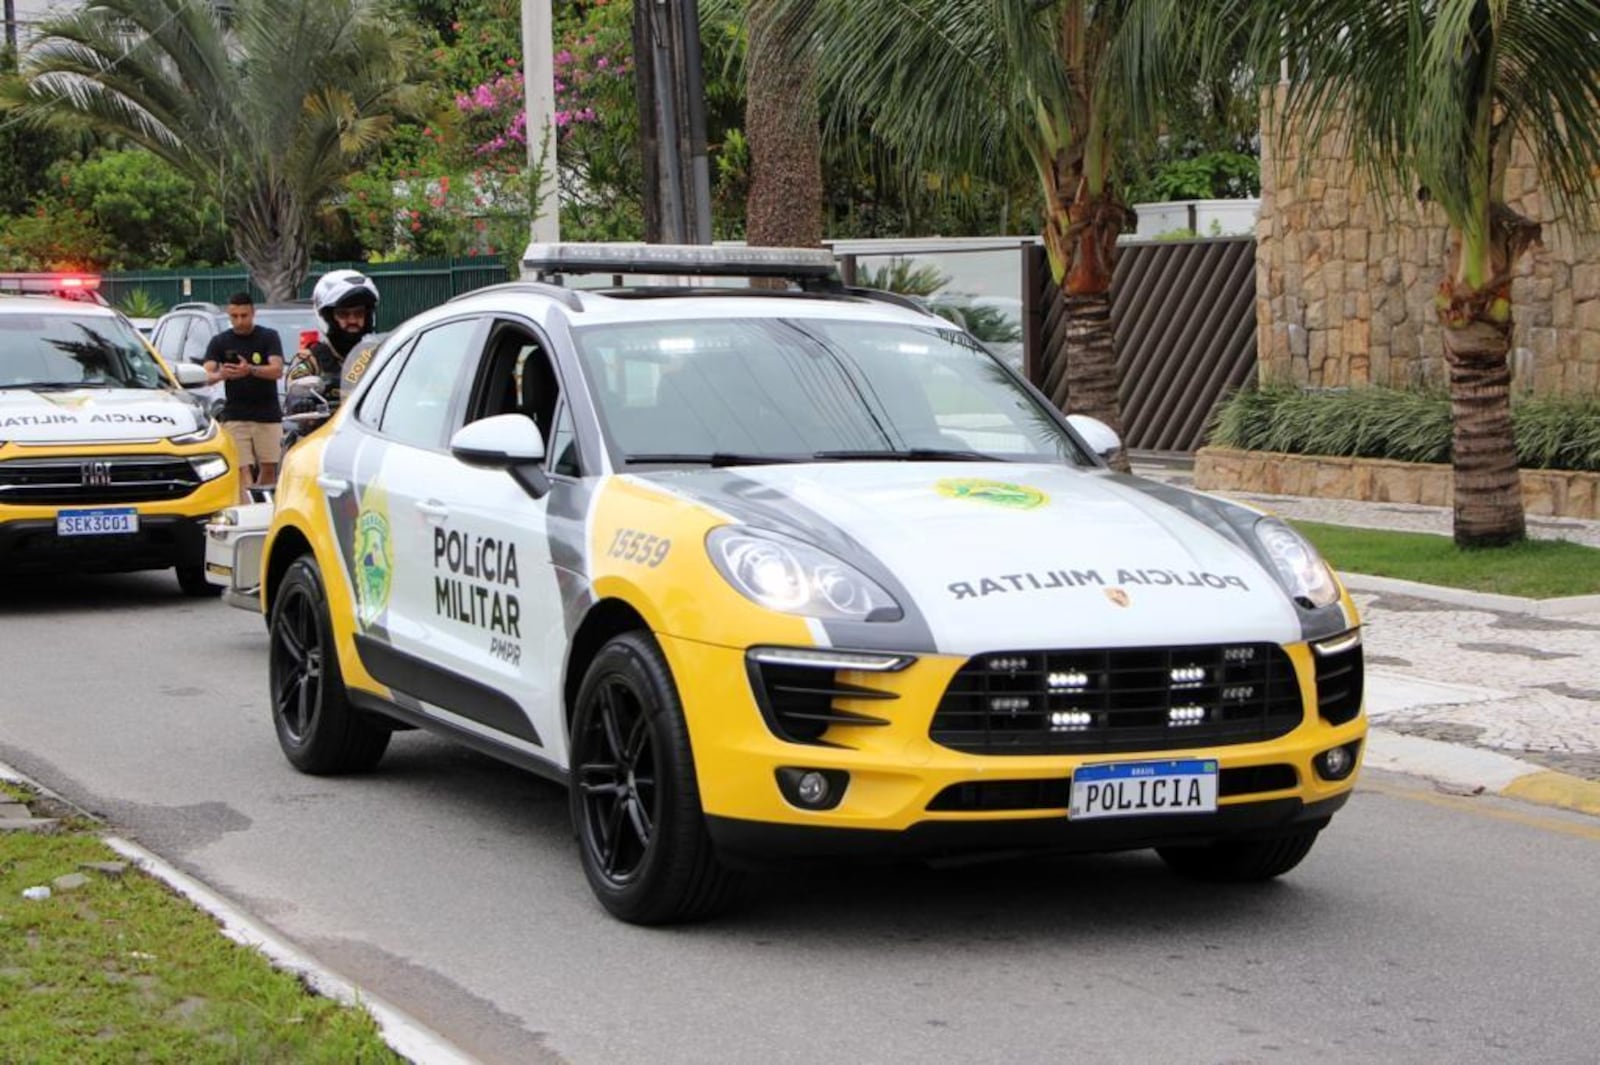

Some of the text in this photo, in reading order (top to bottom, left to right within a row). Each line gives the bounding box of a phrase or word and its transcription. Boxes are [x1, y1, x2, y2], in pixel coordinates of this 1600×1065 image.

[607, 528, 671, 567] 15559
[434, 576, 521, 639] MILITAR
[489, 637, 521, 667] PMPR
[1086, 778, 1202, 813] POLICIA
